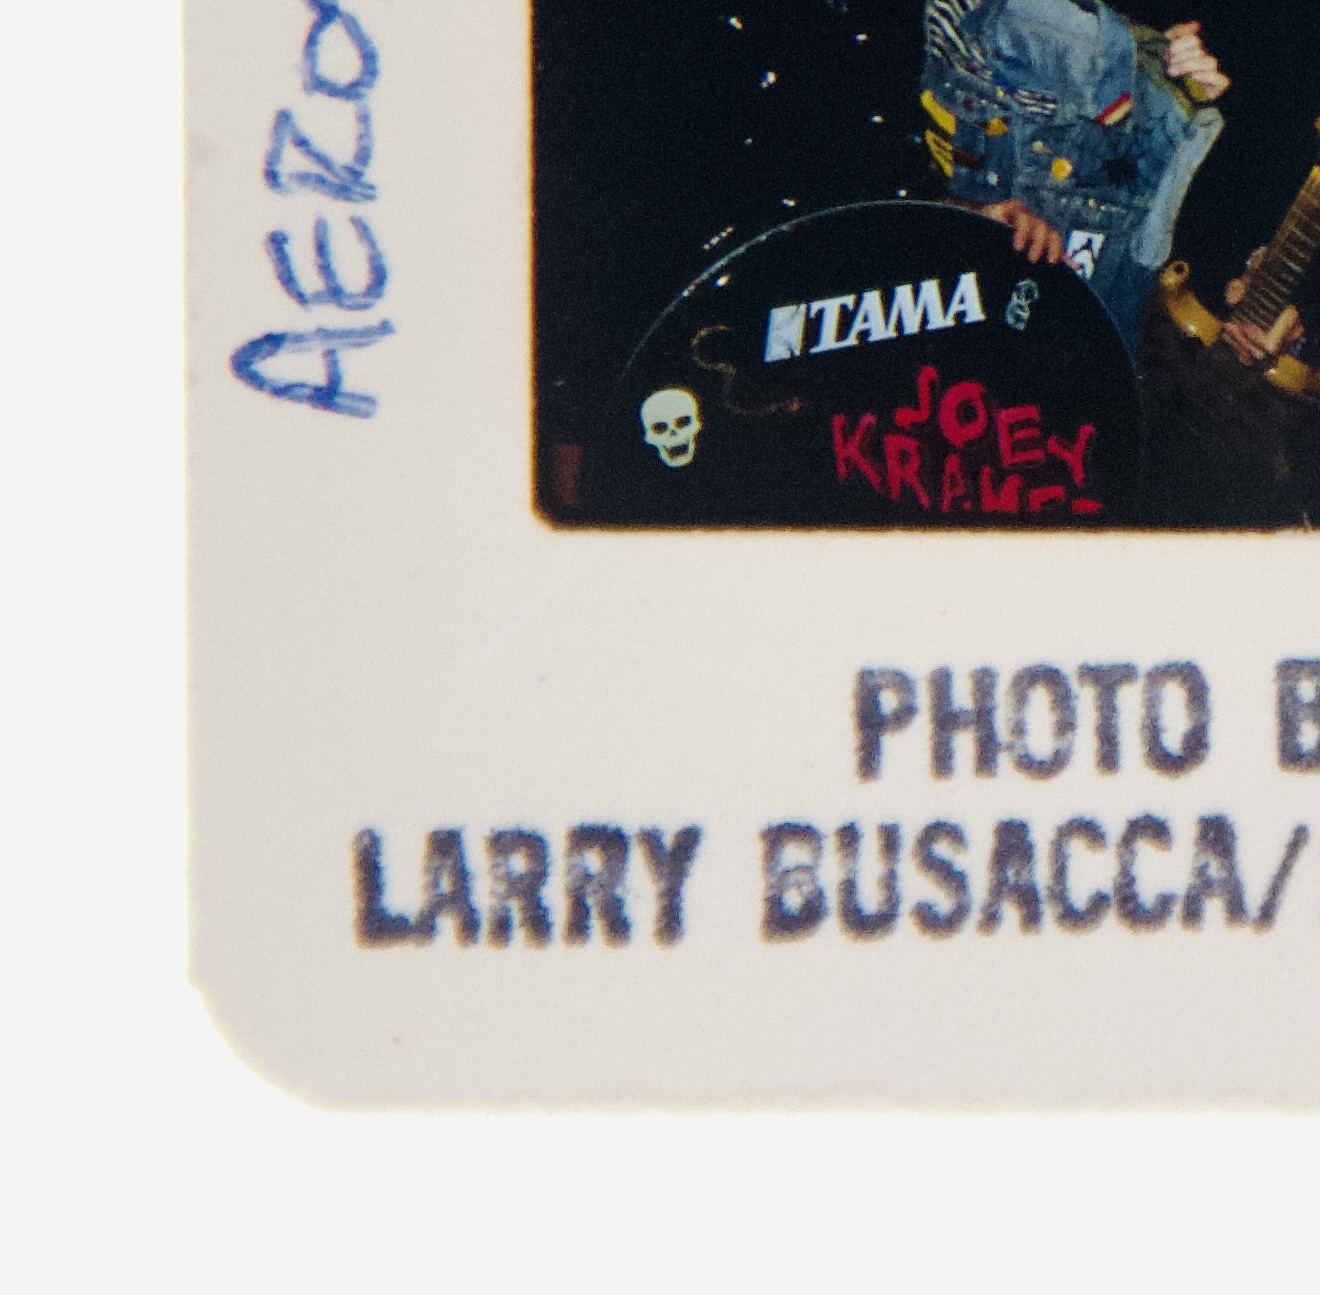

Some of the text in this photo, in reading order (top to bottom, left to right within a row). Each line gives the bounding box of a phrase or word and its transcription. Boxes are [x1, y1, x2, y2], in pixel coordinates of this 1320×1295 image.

[808, 272, 986, 355] TAMA
[894, 365, 1096, 489] JOEY
[854, 660, 1211, 782] PHOTO
[353, 821, 704, 949] LARRY
